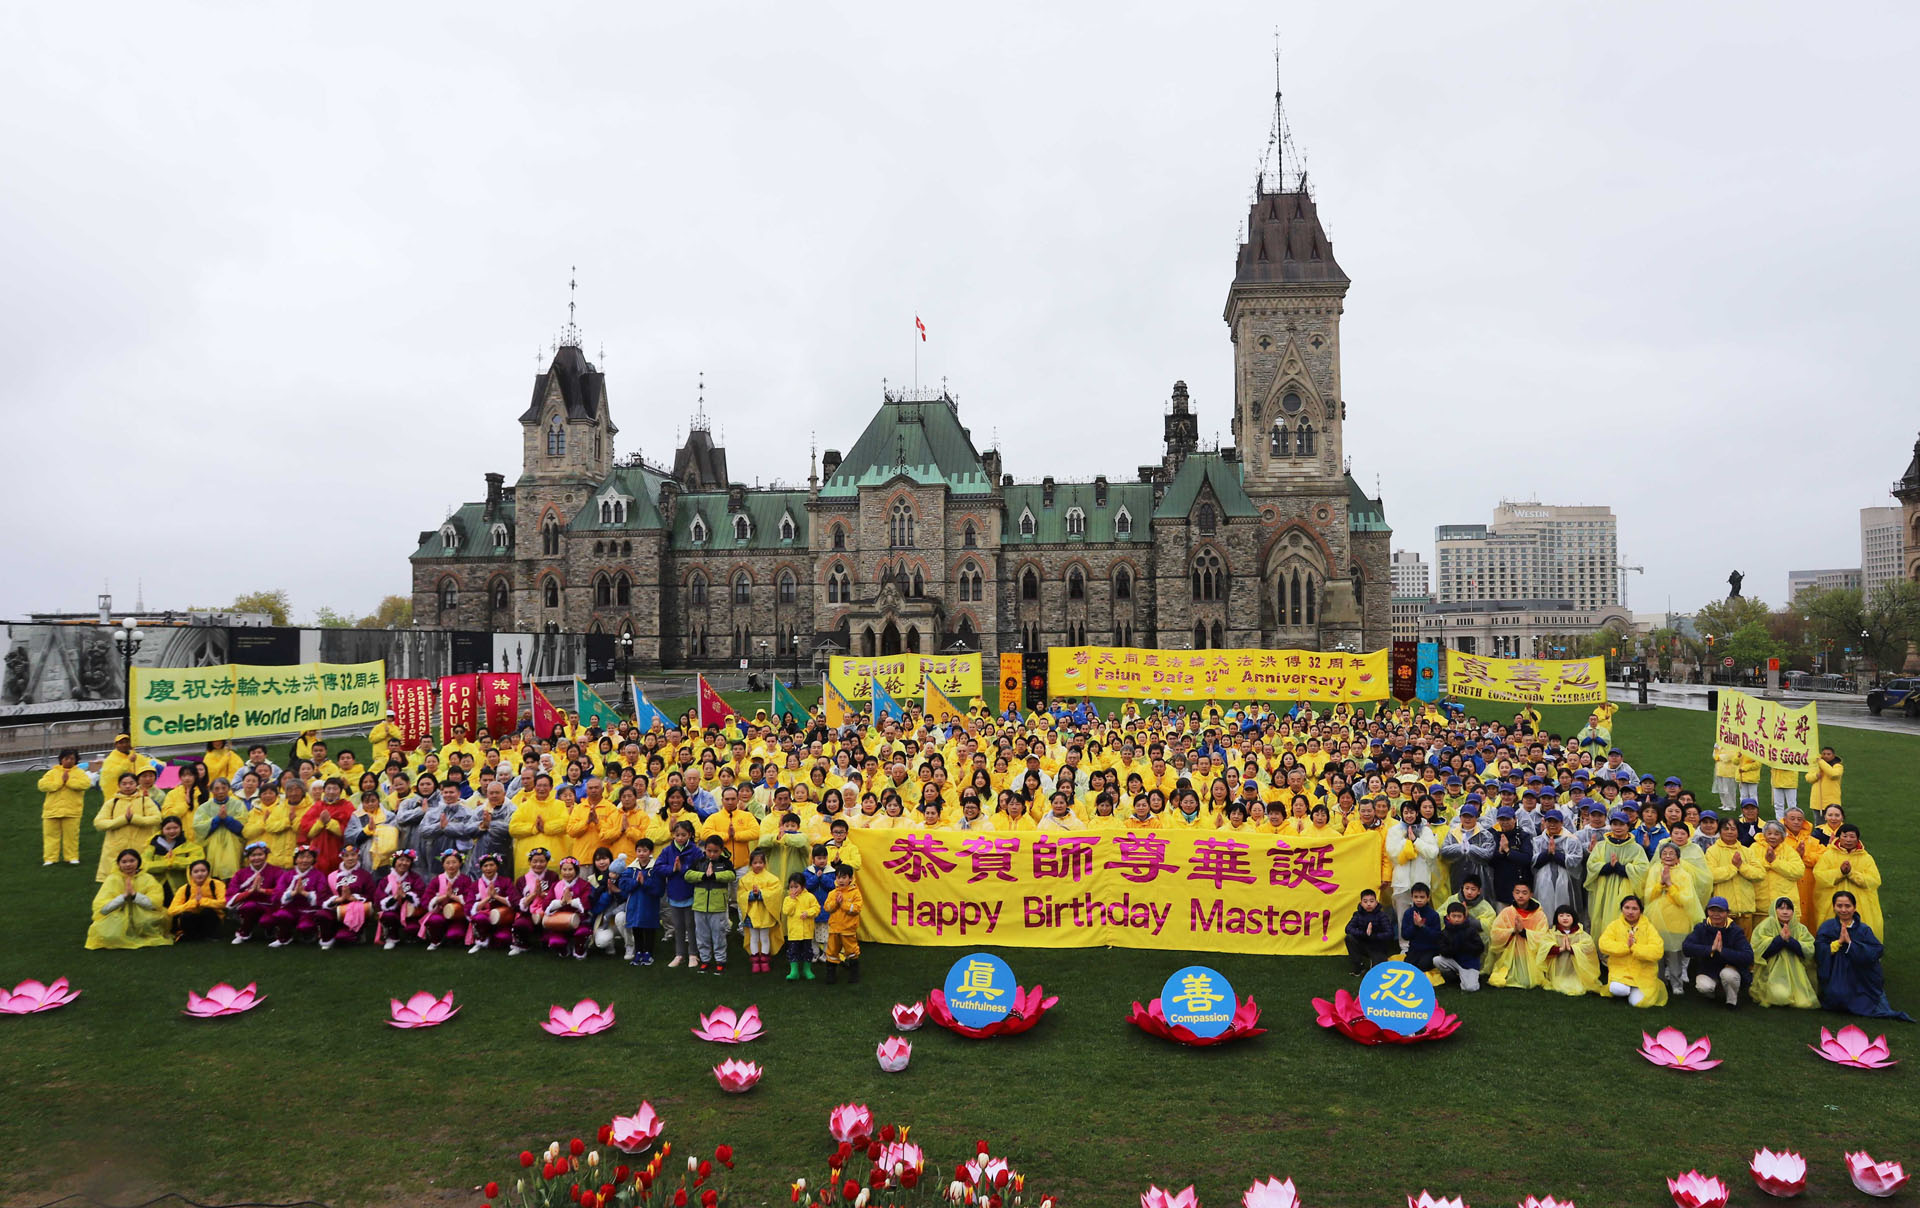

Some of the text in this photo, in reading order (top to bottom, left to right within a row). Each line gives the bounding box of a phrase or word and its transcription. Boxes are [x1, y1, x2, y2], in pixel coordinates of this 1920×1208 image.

[843, 657, 971, 676] Falun Dafa
[1094, 667, 1141, 682] Falun
[1153, 670, 1195, 684] Dafa
[1241, 670, 1347, 690] Anniversary
[461, 687, 471, 731] DAFA
[1451, 683, 1601, 704] TRUTH COMPASSION TOLERANCE
[143, 700, 380, 736] Celebrate World Falun Dafa Day
[407, 687, 416, 740] COMPASSION
[1719, 724, 1810, 766] Falun Dafa is Good
[883, 832, 1340, 895] 恭賀師尊華誕
[891, 891, 1332, 942] Happy Birthday Master!
[950, 998, 1007, 1013] Truthfulness
[1172, 973, 1225, 1012] 善
[1370, 968, 1424, 1009] 忍
[1170, 1013, 1230, 1024] Compassion
[1366, 1006, 1429, 1020] Forbearance
